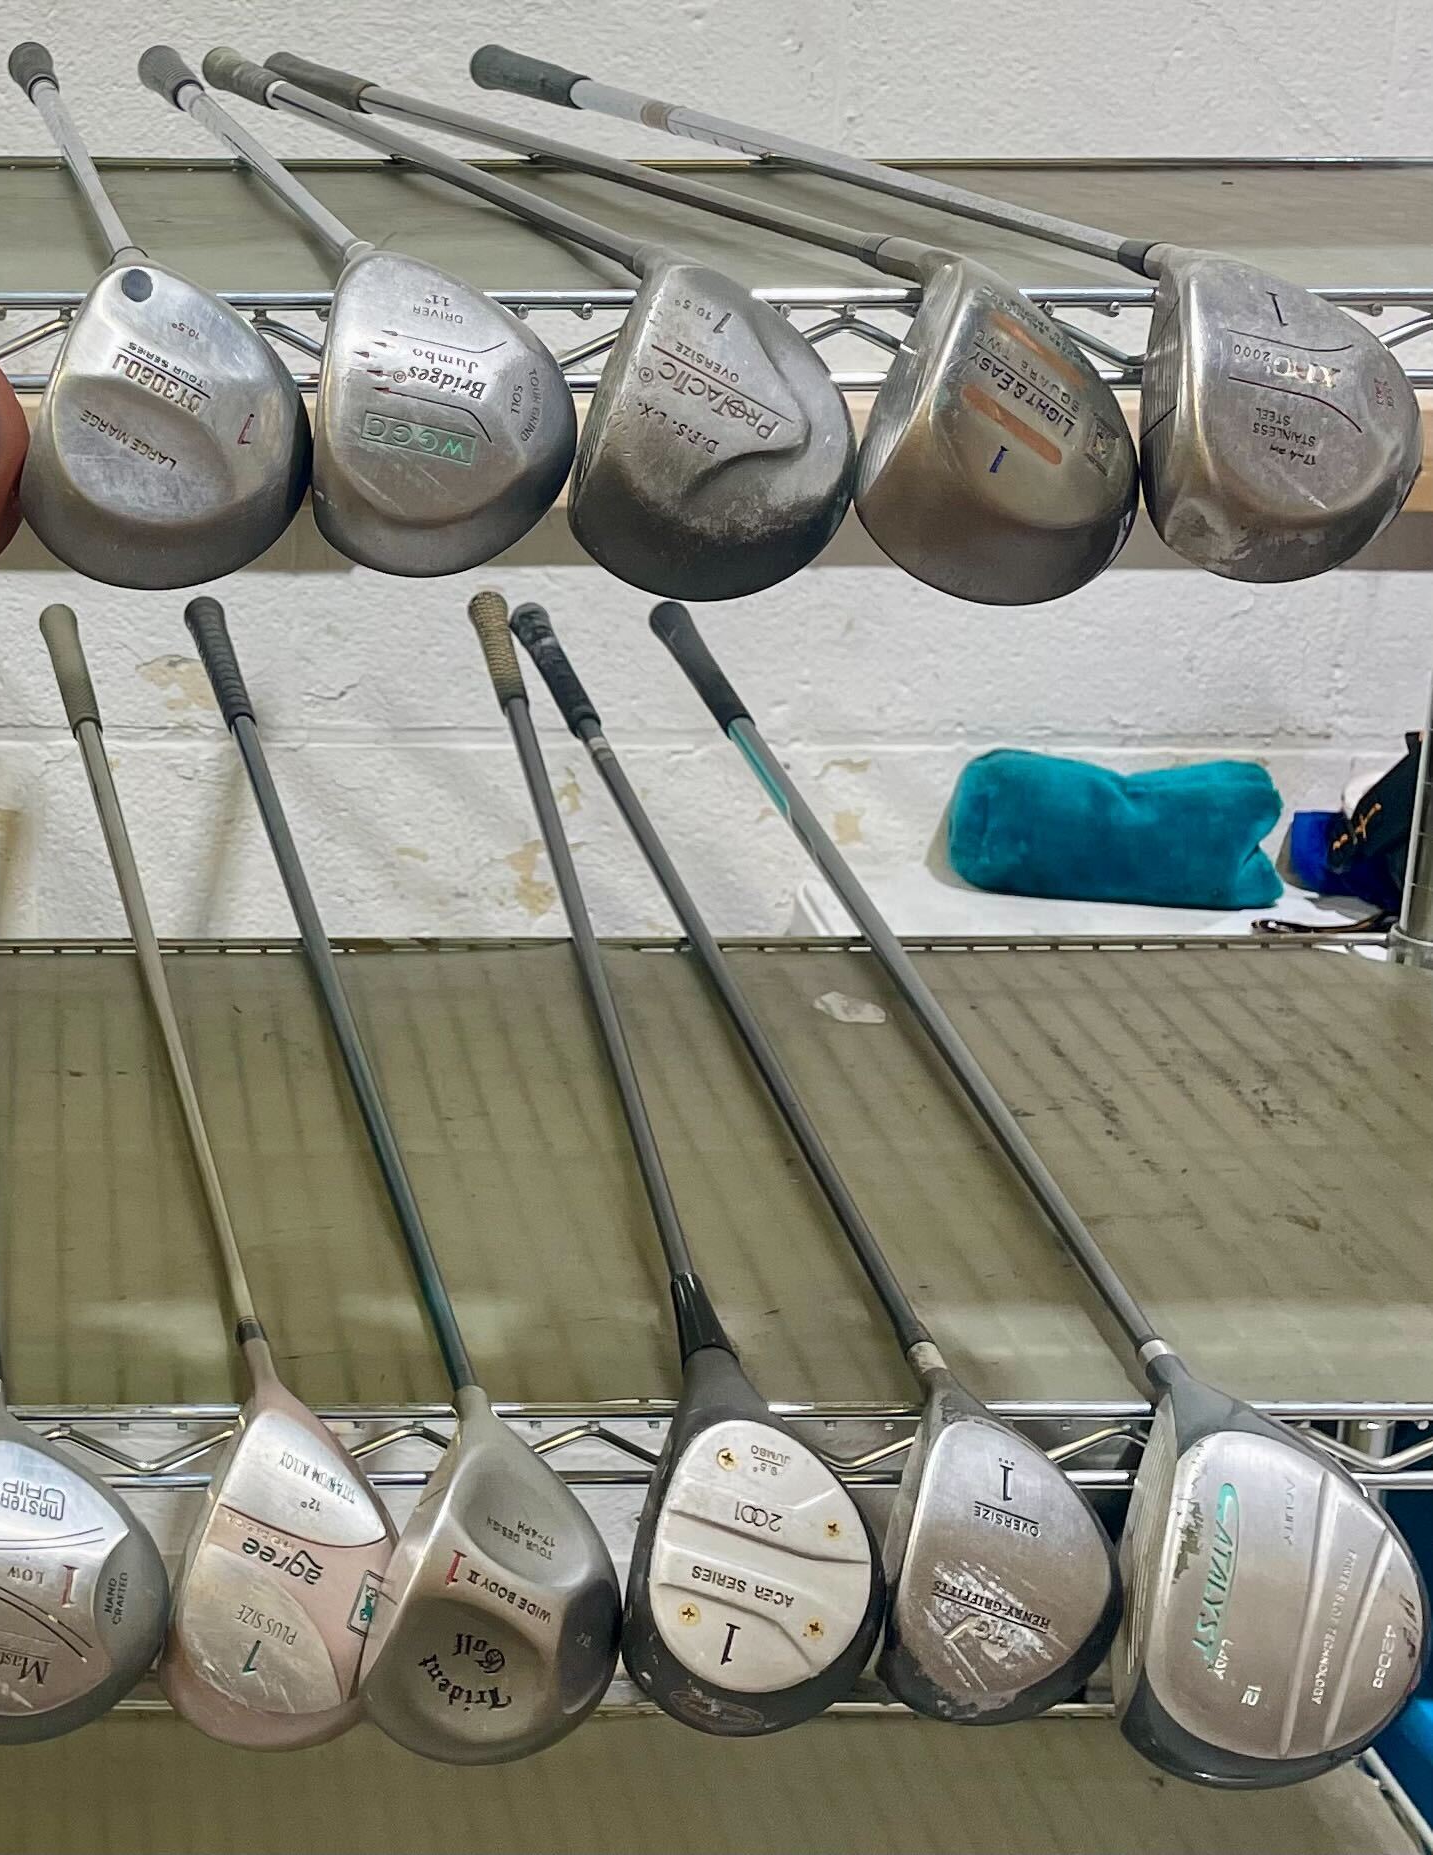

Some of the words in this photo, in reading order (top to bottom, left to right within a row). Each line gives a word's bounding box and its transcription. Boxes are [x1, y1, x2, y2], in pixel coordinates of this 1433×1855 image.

[412, 305, 463, 323] DRIVER
[1265, 292, 1286, 327] 1
[127, 341, 169, 369] SERIES
[411, 347, 478, 371] Jumbo
[673, 341, 740, 383] OVERSIZE
[1232, 343, 1270, 361] 2000
[172, 365, 203, 388] TOUR
[79, 408, 129, 444] MARGE
[1253, 406, 1290, 426] STEEL
[367, 417, 465, 461] WGGC
[1252, 421, 1315, 447] STAINLESS
[128, 437, 176, 471] LARGE
[278, 1450, 310, 1478] ALLOY
[999, 1465, 1013, 1501] 1
[733, 1501, 783, 1532] 2001
[973, 1505, 1040, 1537] OVERSIZE
[239, 1536, 324, 1587] agree
[525, 1539, 552, 1560] TOUR
[5, 1564, 44, 1584] LOW
[444, 1549, 466, 1585] 1
[690, 1565, 746, 1591] SERIES
[1192, 1483, 1239, 1661] CATALYST
[61, 1564, 79, 1608] 1
[103, 1577, 117, 1613] HAND
[479, 1574, 516, 1602] BODY
[753, 1585, 794, 1607] ACER
[234, 1602, 263, 1630] SIZE
[517, 1597, 551, 1623] WIDE
[263, 1616, 297, 1646] PLUS
[719, 1622, 741, 1665] 1
[239, 1639, 262, 1674] 1
[451, 1632, 505, 1673] Golf
[1310, 1627, 1337, 1705] TECHNOLOGY
[417, 1653, 511, 1711] Trident
